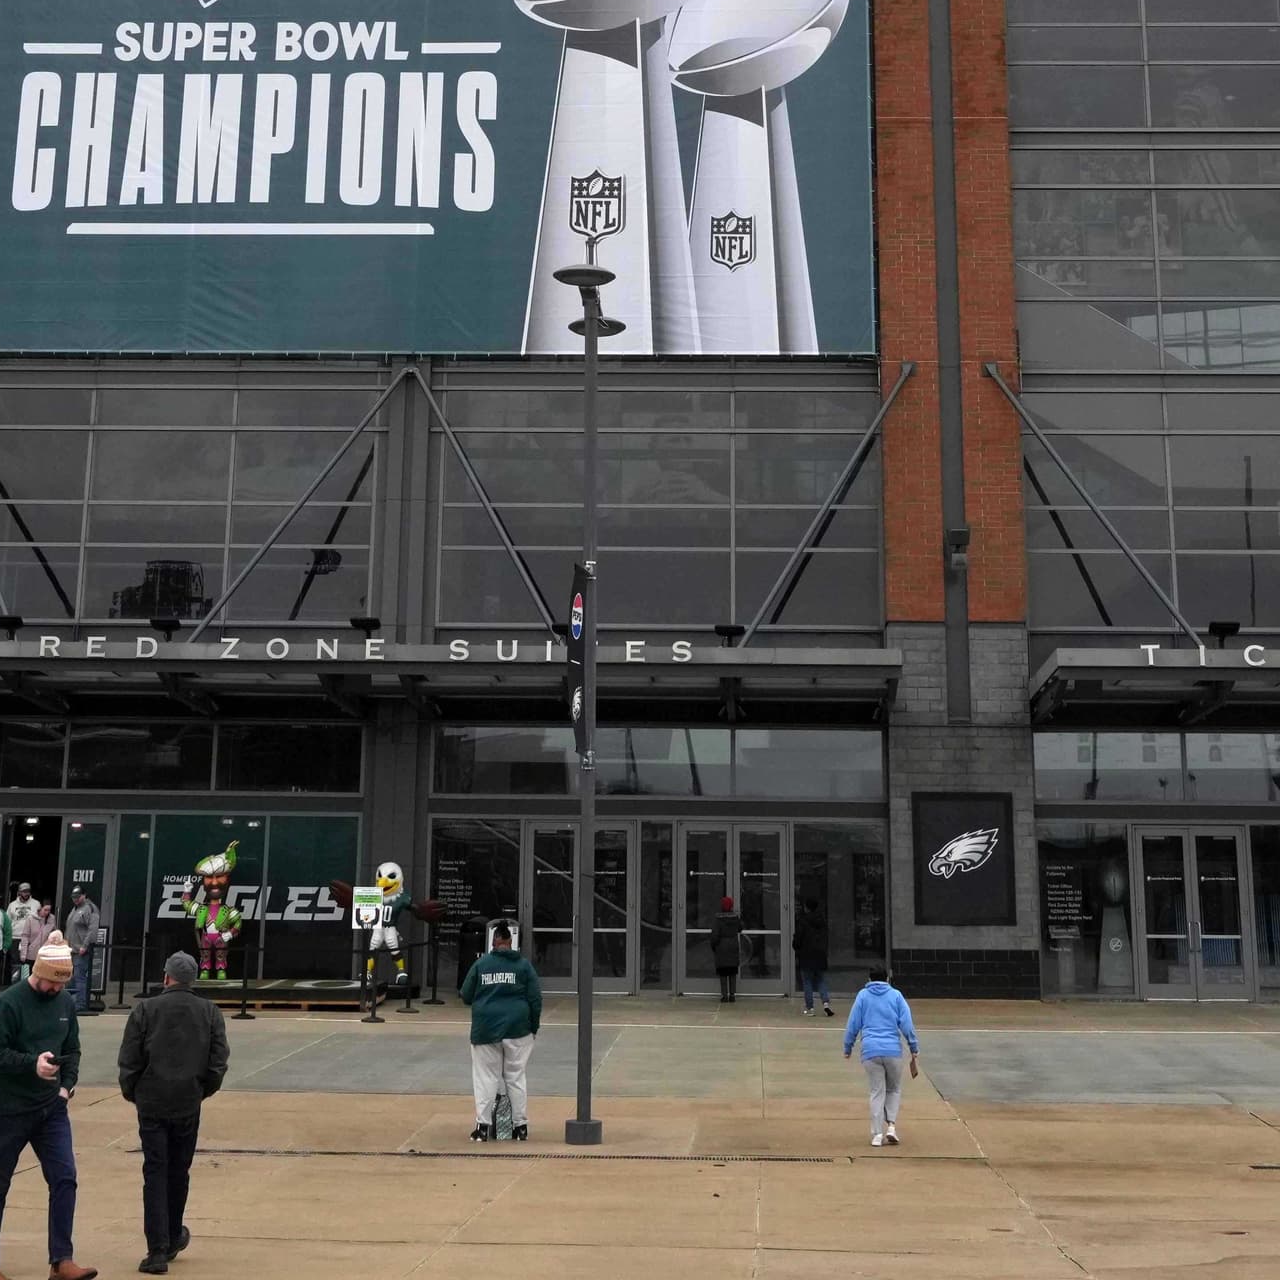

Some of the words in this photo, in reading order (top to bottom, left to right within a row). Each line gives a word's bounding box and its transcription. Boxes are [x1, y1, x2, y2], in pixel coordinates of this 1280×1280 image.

[114, 21, 257, 62] SUPER
[275, 21, 408, 61] BOWL
[11, 71, 498, 212] CHAMPIONS
[572, 196, 618, 237] NFL
[711, 230, 751, 263] NFL
[39, 636, 159, 657] RED
[220, 637, 385, 660] ZONE
[449, 640, 692, 663] SUIES
[73, 870, 94, 882] EXIT
[190, 875, 202, 883] OF
